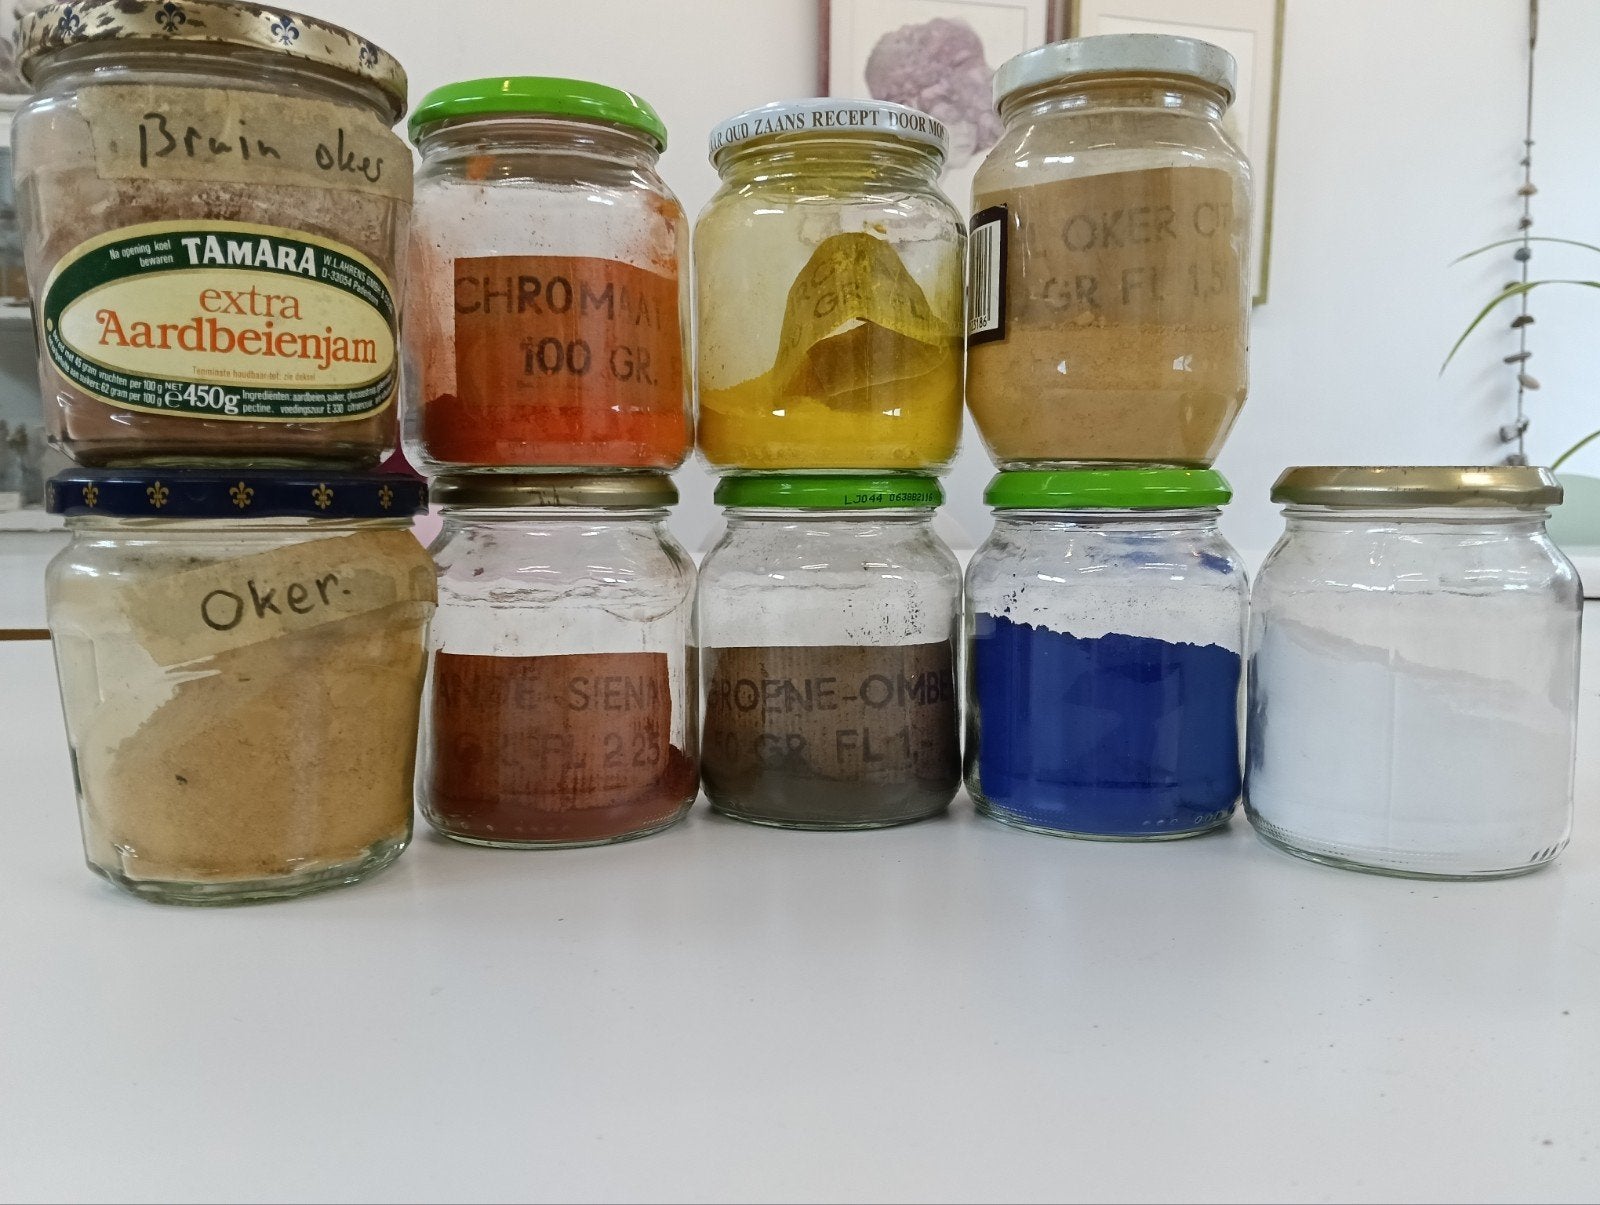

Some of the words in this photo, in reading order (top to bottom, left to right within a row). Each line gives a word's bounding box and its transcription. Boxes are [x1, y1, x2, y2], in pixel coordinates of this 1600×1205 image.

[725, 122, 749, 143] OUD
[754, 112, 805, 135] ZAANS
[811, 109, 879, 128] RECEPT
[887, 111, 926, 133] DOOR
[928, 118, 946, 141] MOS
[1062, 206, 1177, 252] OKER
[109, 248, 120, 261] Na
[121, 243, 151, 257] opening
[153, 239, 172, 250] koel
[139, 254, 174, 268] bewaren
[181, 235, 316, 277] TAMARA
[199, 285, 304, 321] extra
[95, 308, 378, 371] Aardbeienjam
[98, 370, 128, 387] vruchten
[130, 379, 143, 389] per
[143, 379, 157, 392] 100
[110, 386, 129, 399] gram
[128, 391, 142, 402] per
[143, 392, 157, 405] 100
[164, 381, 185, 392] NET
[183, 383, 241, 415] 450g
[200, 573, 351, 631] Oker.
